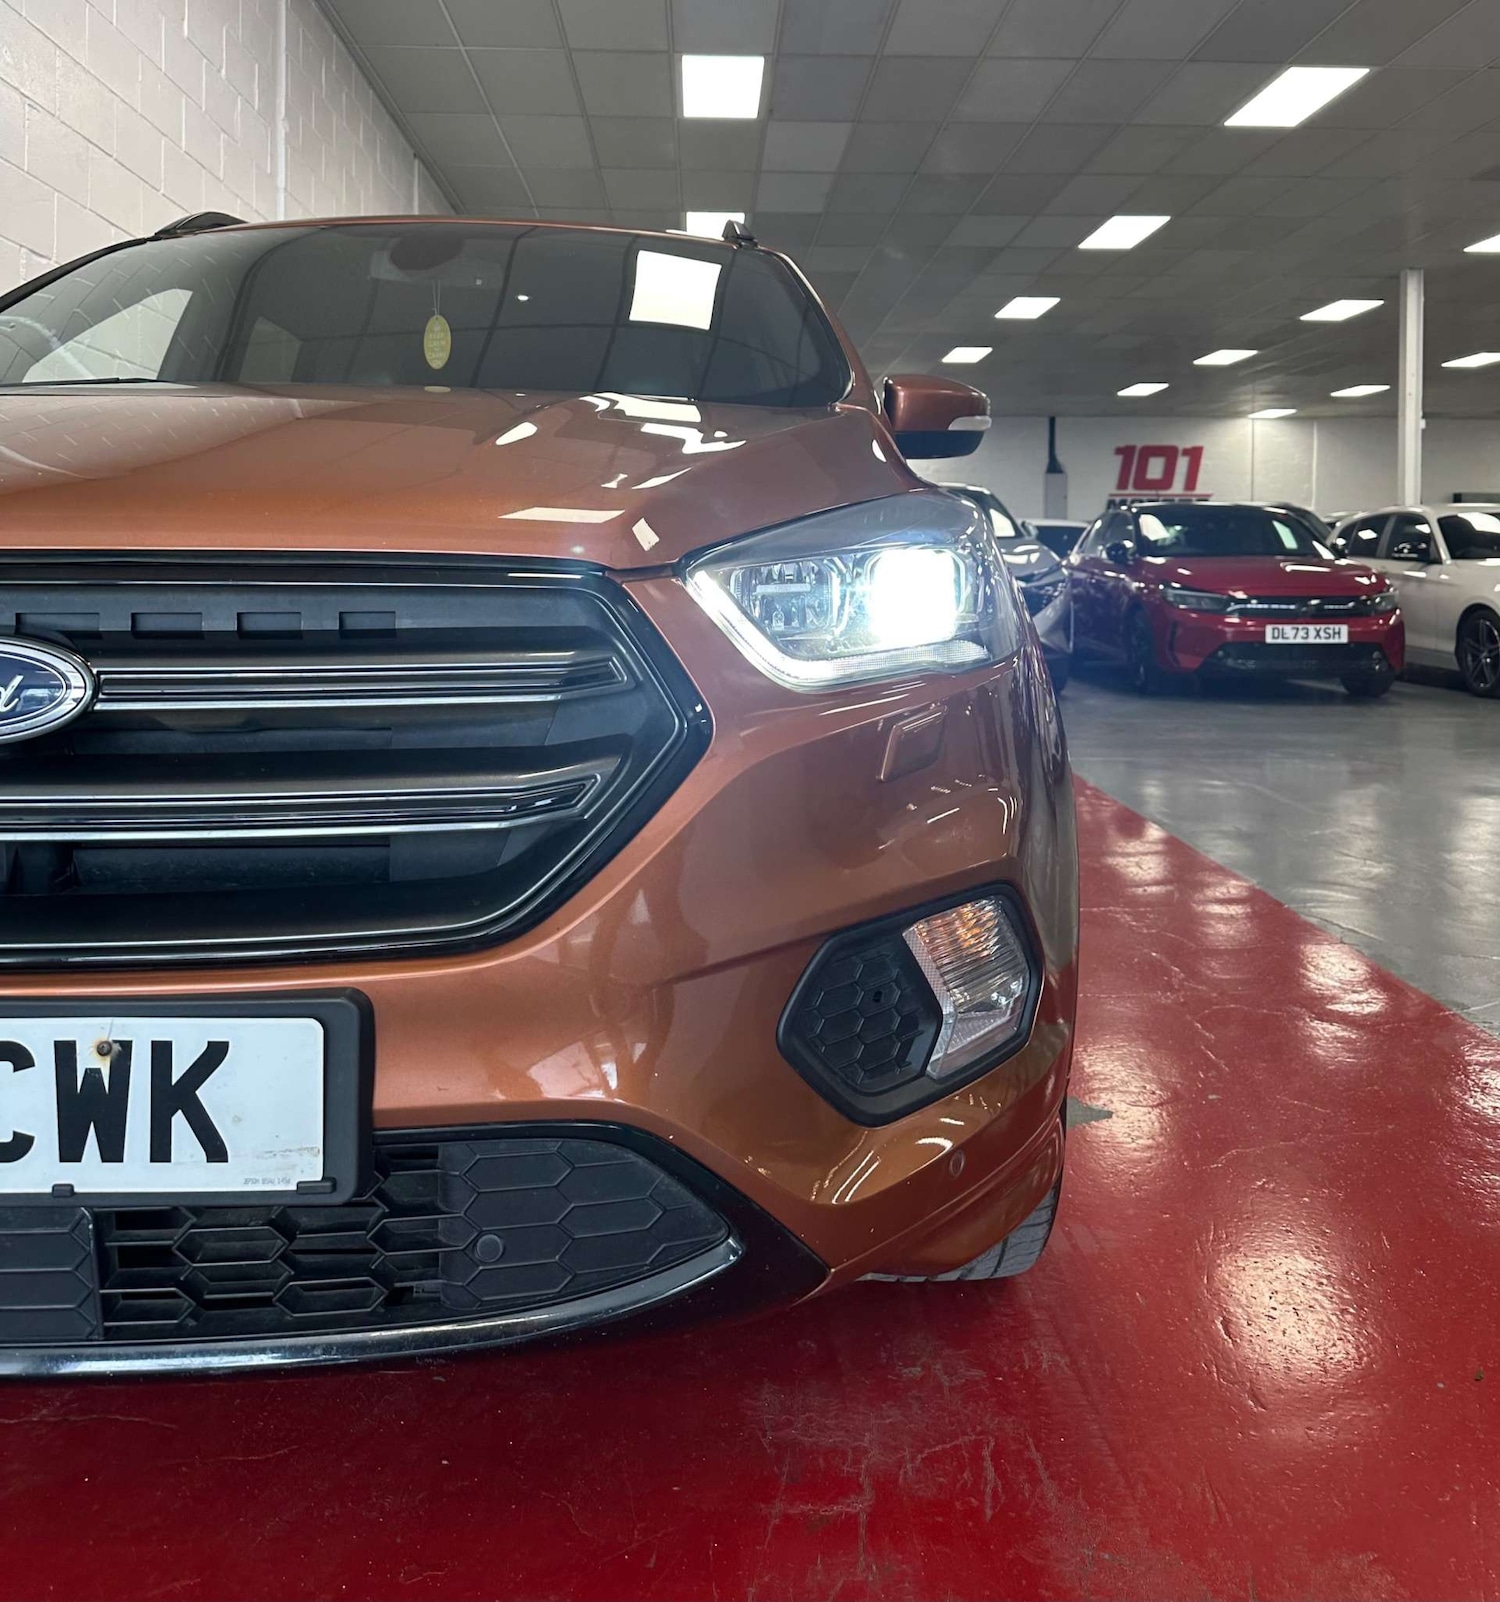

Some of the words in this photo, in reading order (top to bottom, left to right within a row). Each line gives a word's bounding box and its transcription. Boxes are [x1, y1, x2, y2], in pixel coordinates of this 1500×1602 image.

[1114, 444, 1204, 492] 101
[1271, 627, 1310, 640] DL73
[1313, 627, 1342, 640] XSH
